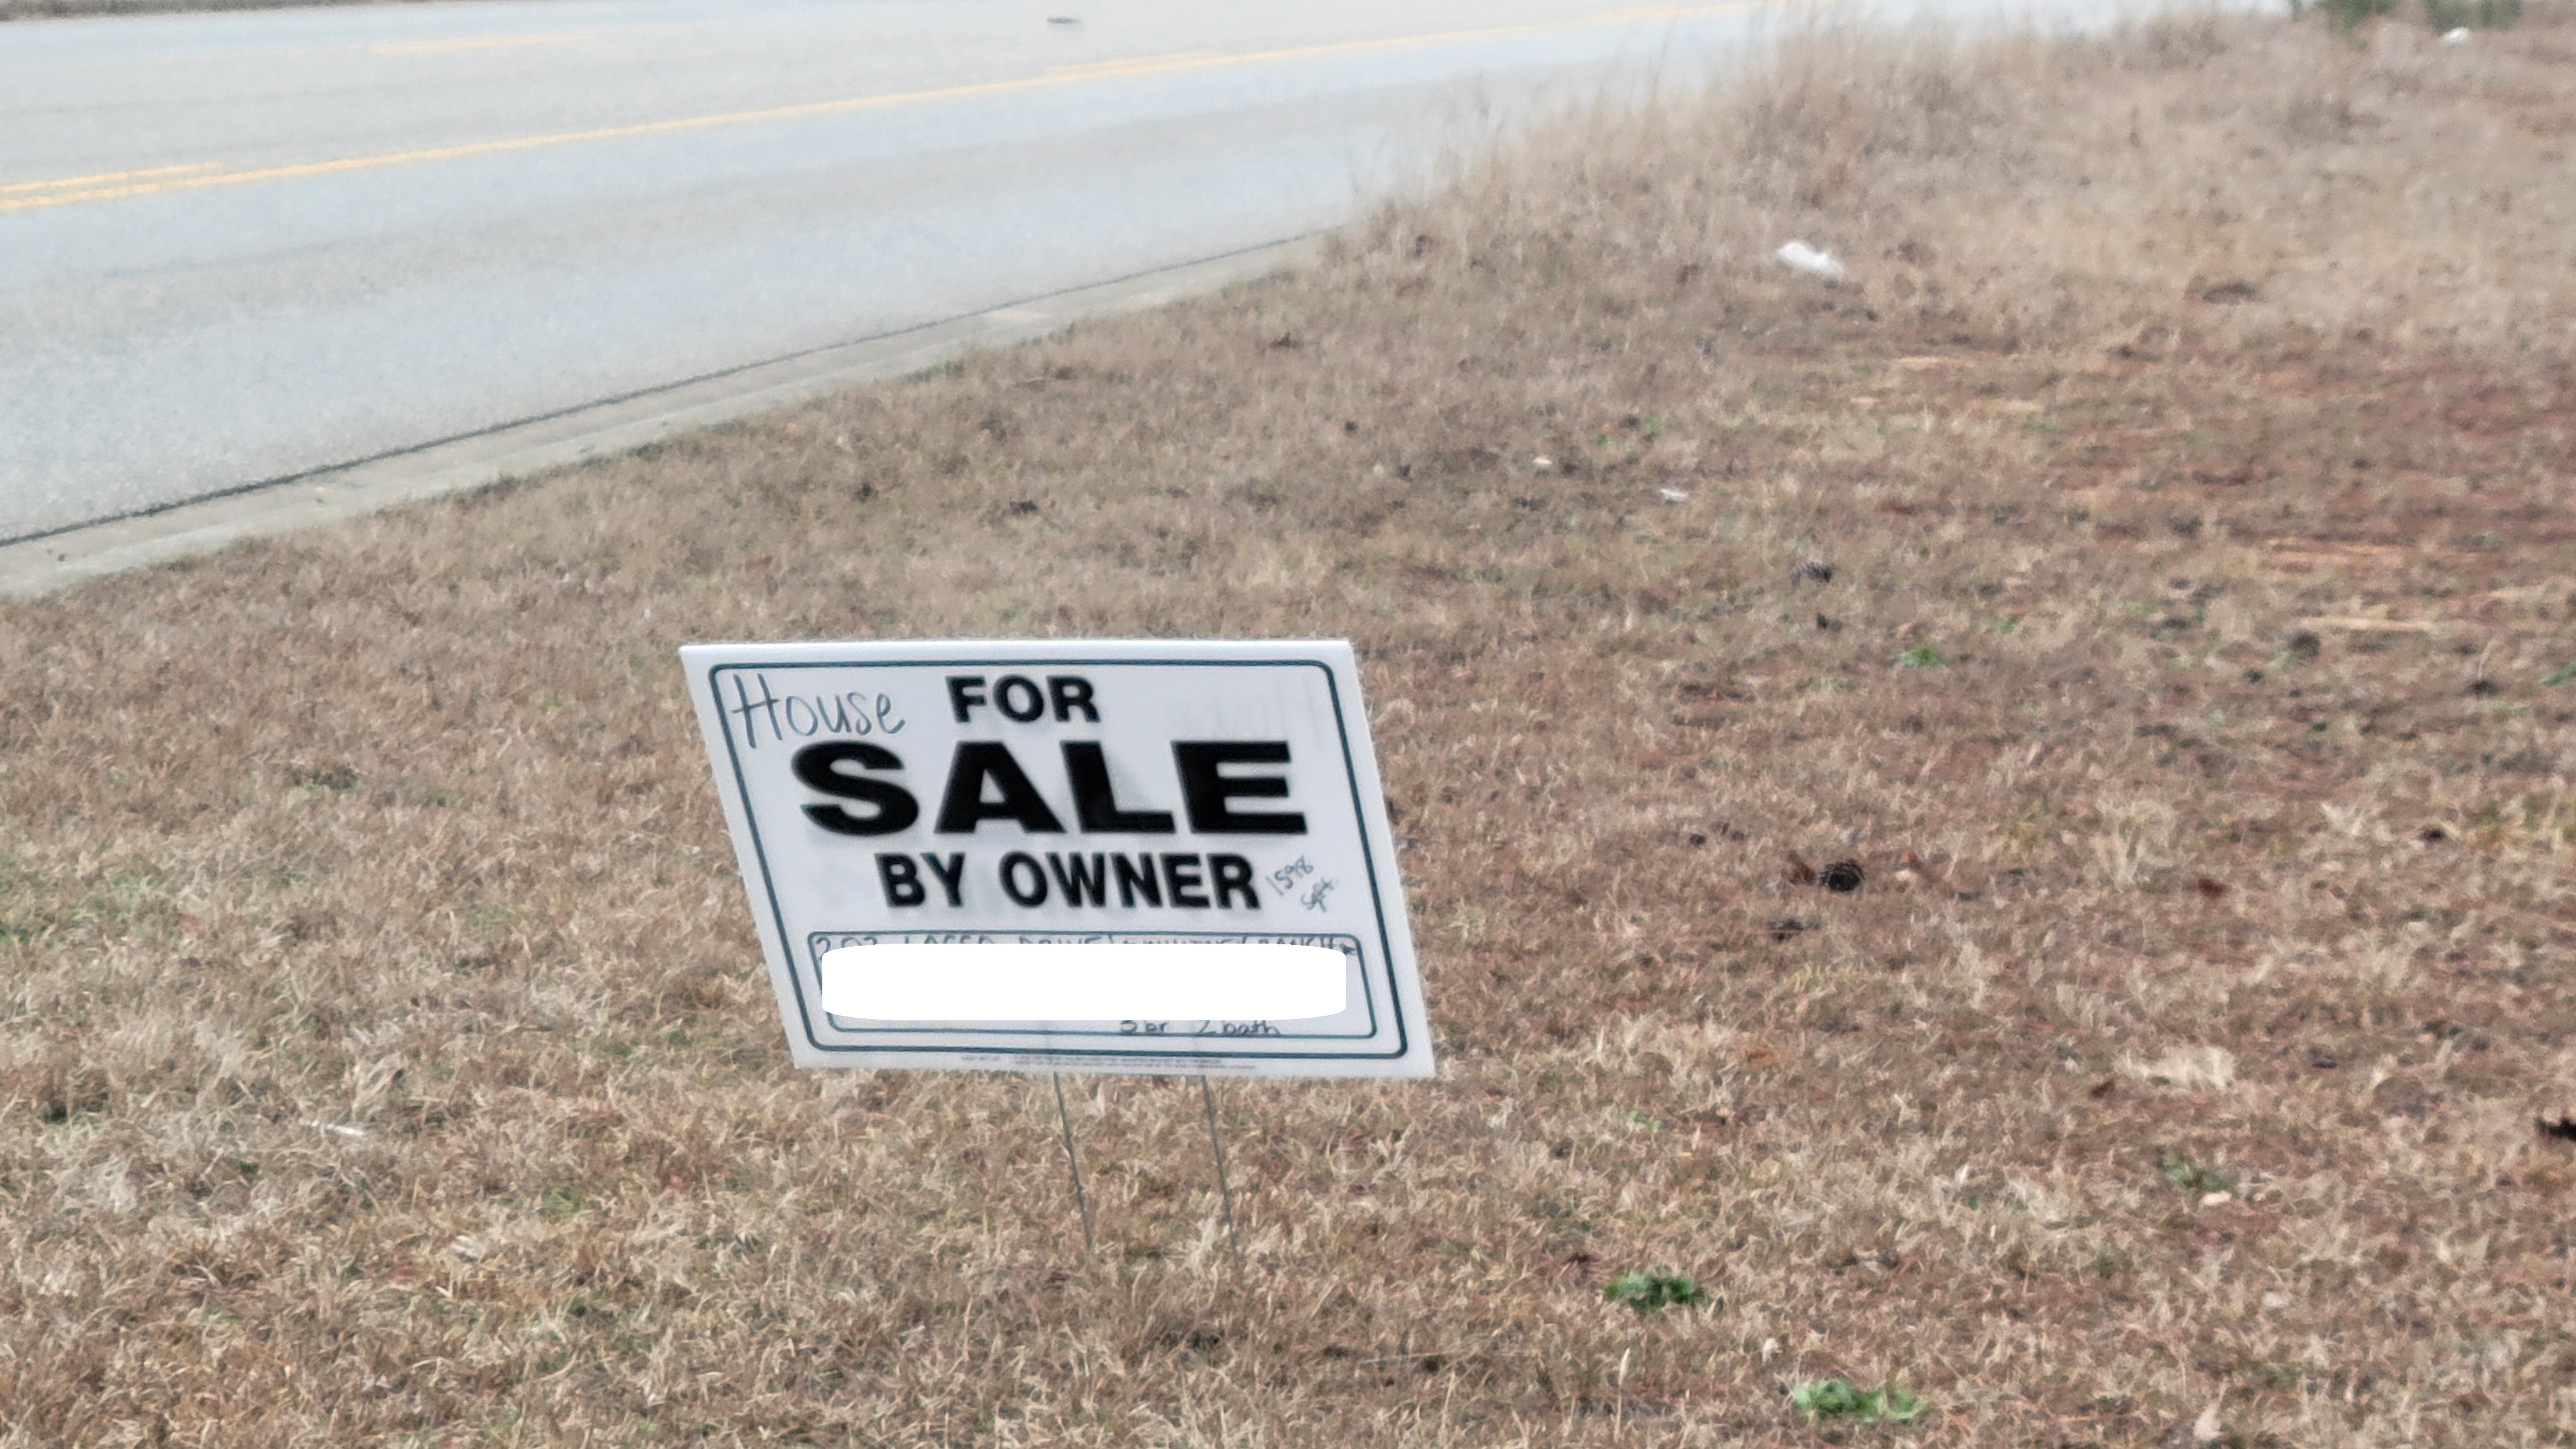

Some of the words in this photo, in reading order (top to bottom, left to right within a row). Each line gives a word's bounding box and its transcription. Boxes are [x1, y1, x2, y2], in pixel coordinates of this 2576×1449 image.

[732, 673, 905, 749] House
[945, 675, 1101, 723] FOR
[791, 740, 1308, 837] SALE
[874, 852, 965, 908] BY
[999, 850, 1261, 910] OWNER
[1265, 854, 1314, 896] 1598
